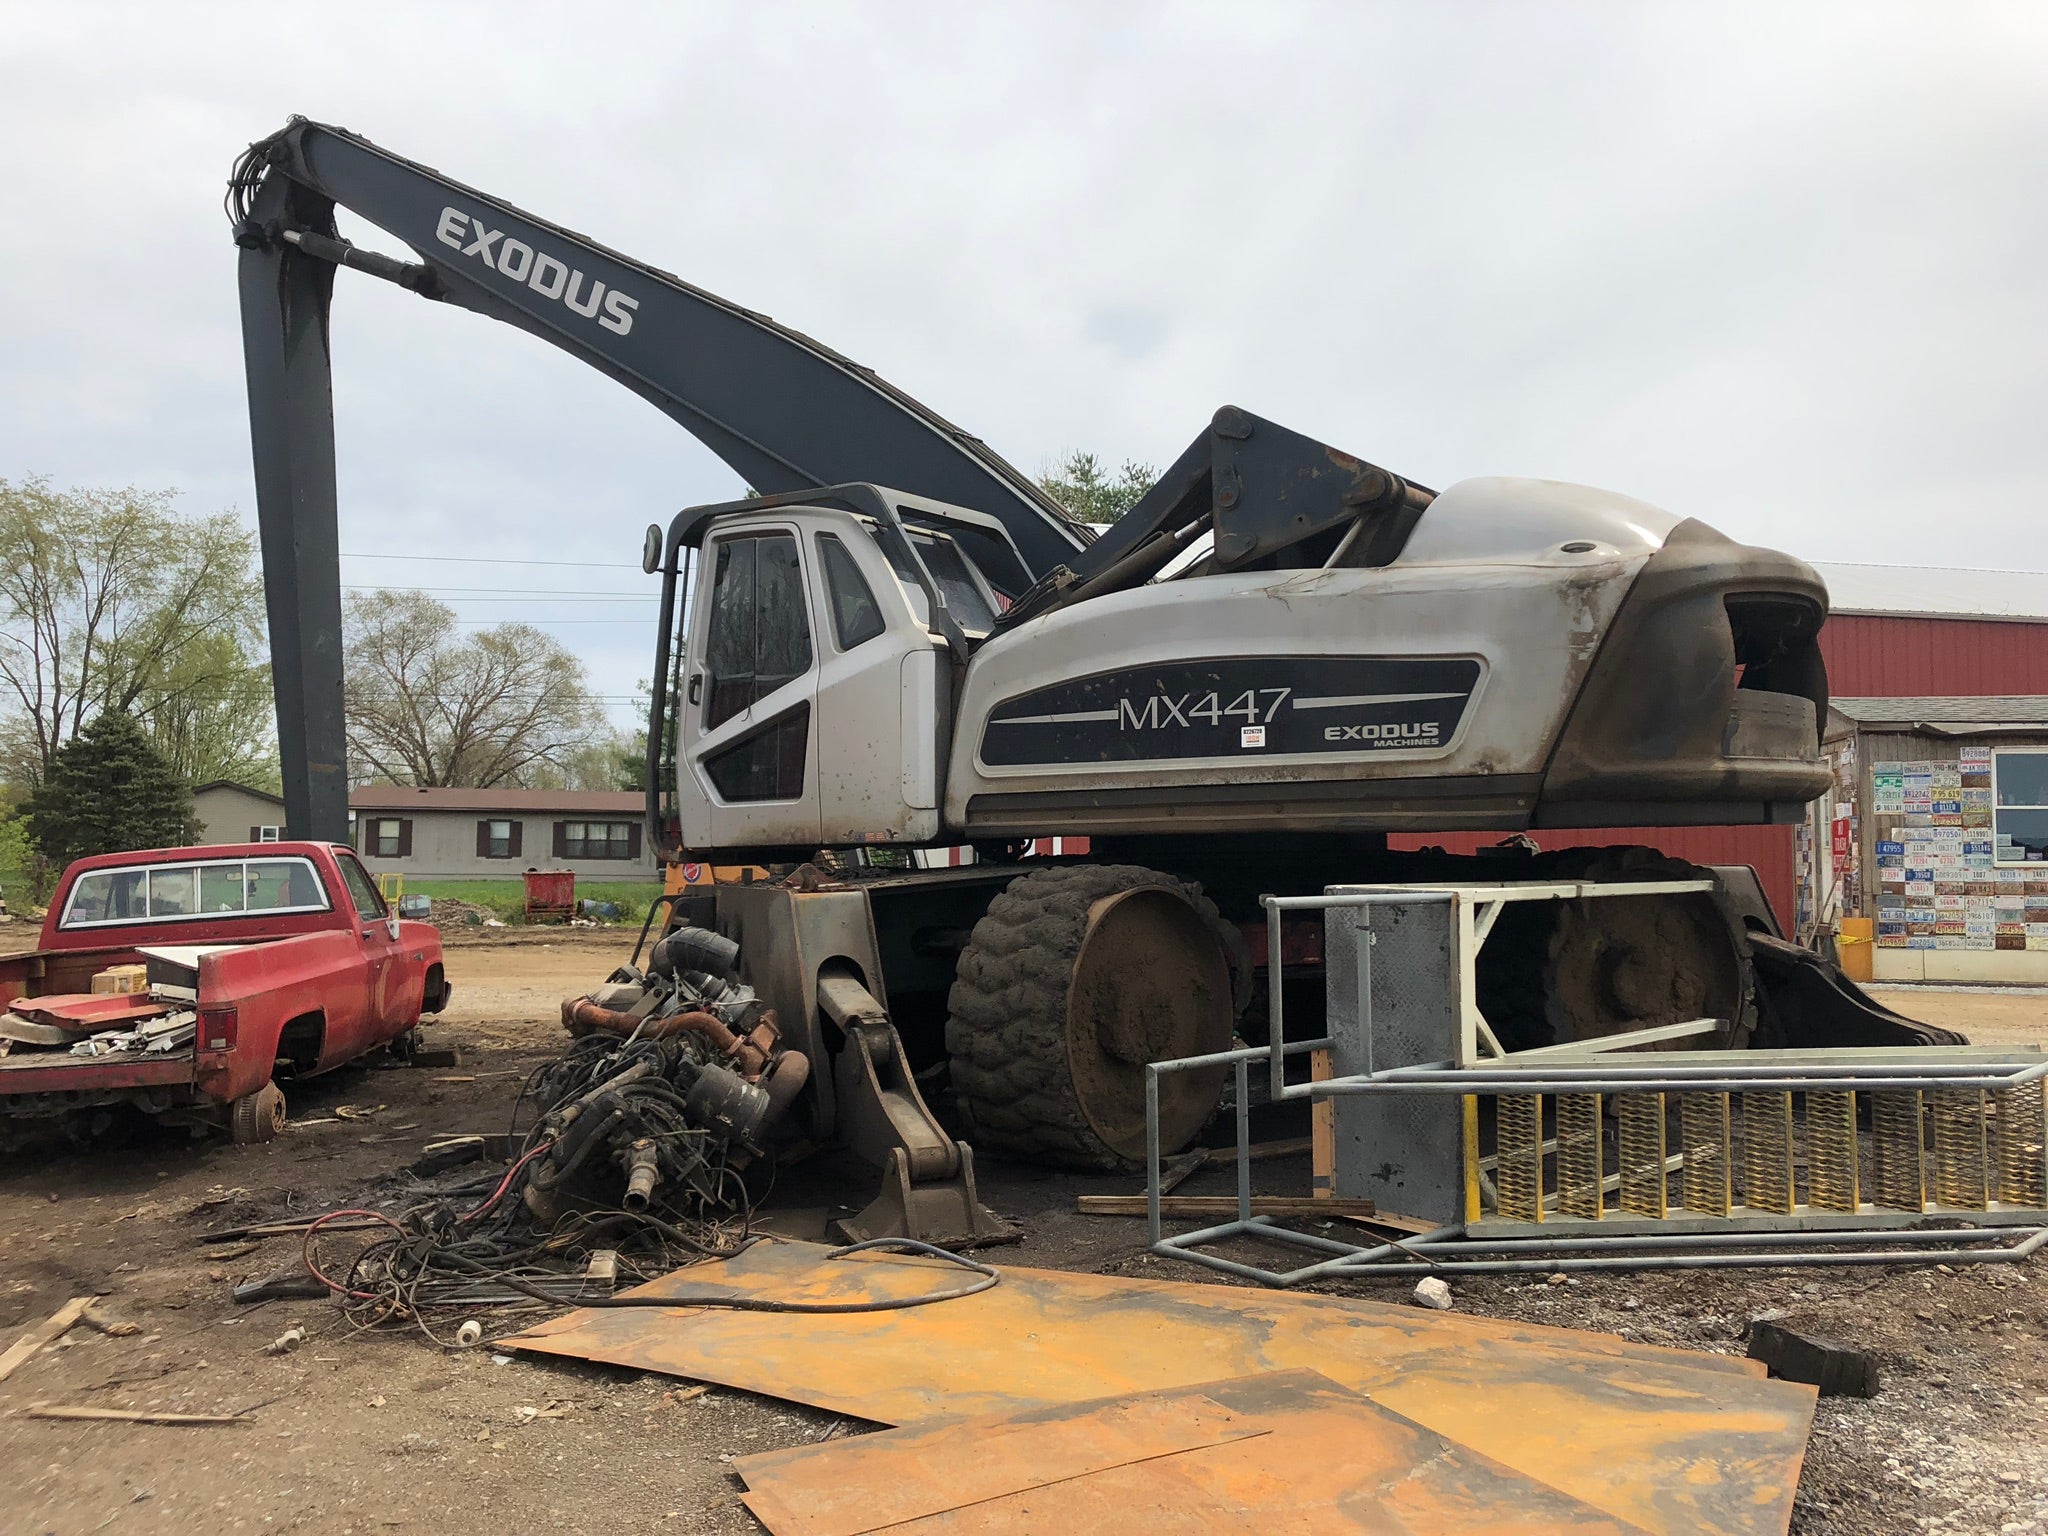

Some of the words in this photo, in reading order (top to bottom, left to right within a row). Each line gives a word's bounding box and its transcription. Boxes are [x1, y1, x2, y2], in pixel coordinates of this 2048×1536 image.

[435, 206, 640, 336] EXODUS
[1119, 687, 1292, 731] MX447
[1324, 722, 1439, 740] EXODUS
[1373, 737, 1440, 747] MACHINES
[1948, 790, 1960, 798] 619
[1883, 845, 1902, 853] 47955
